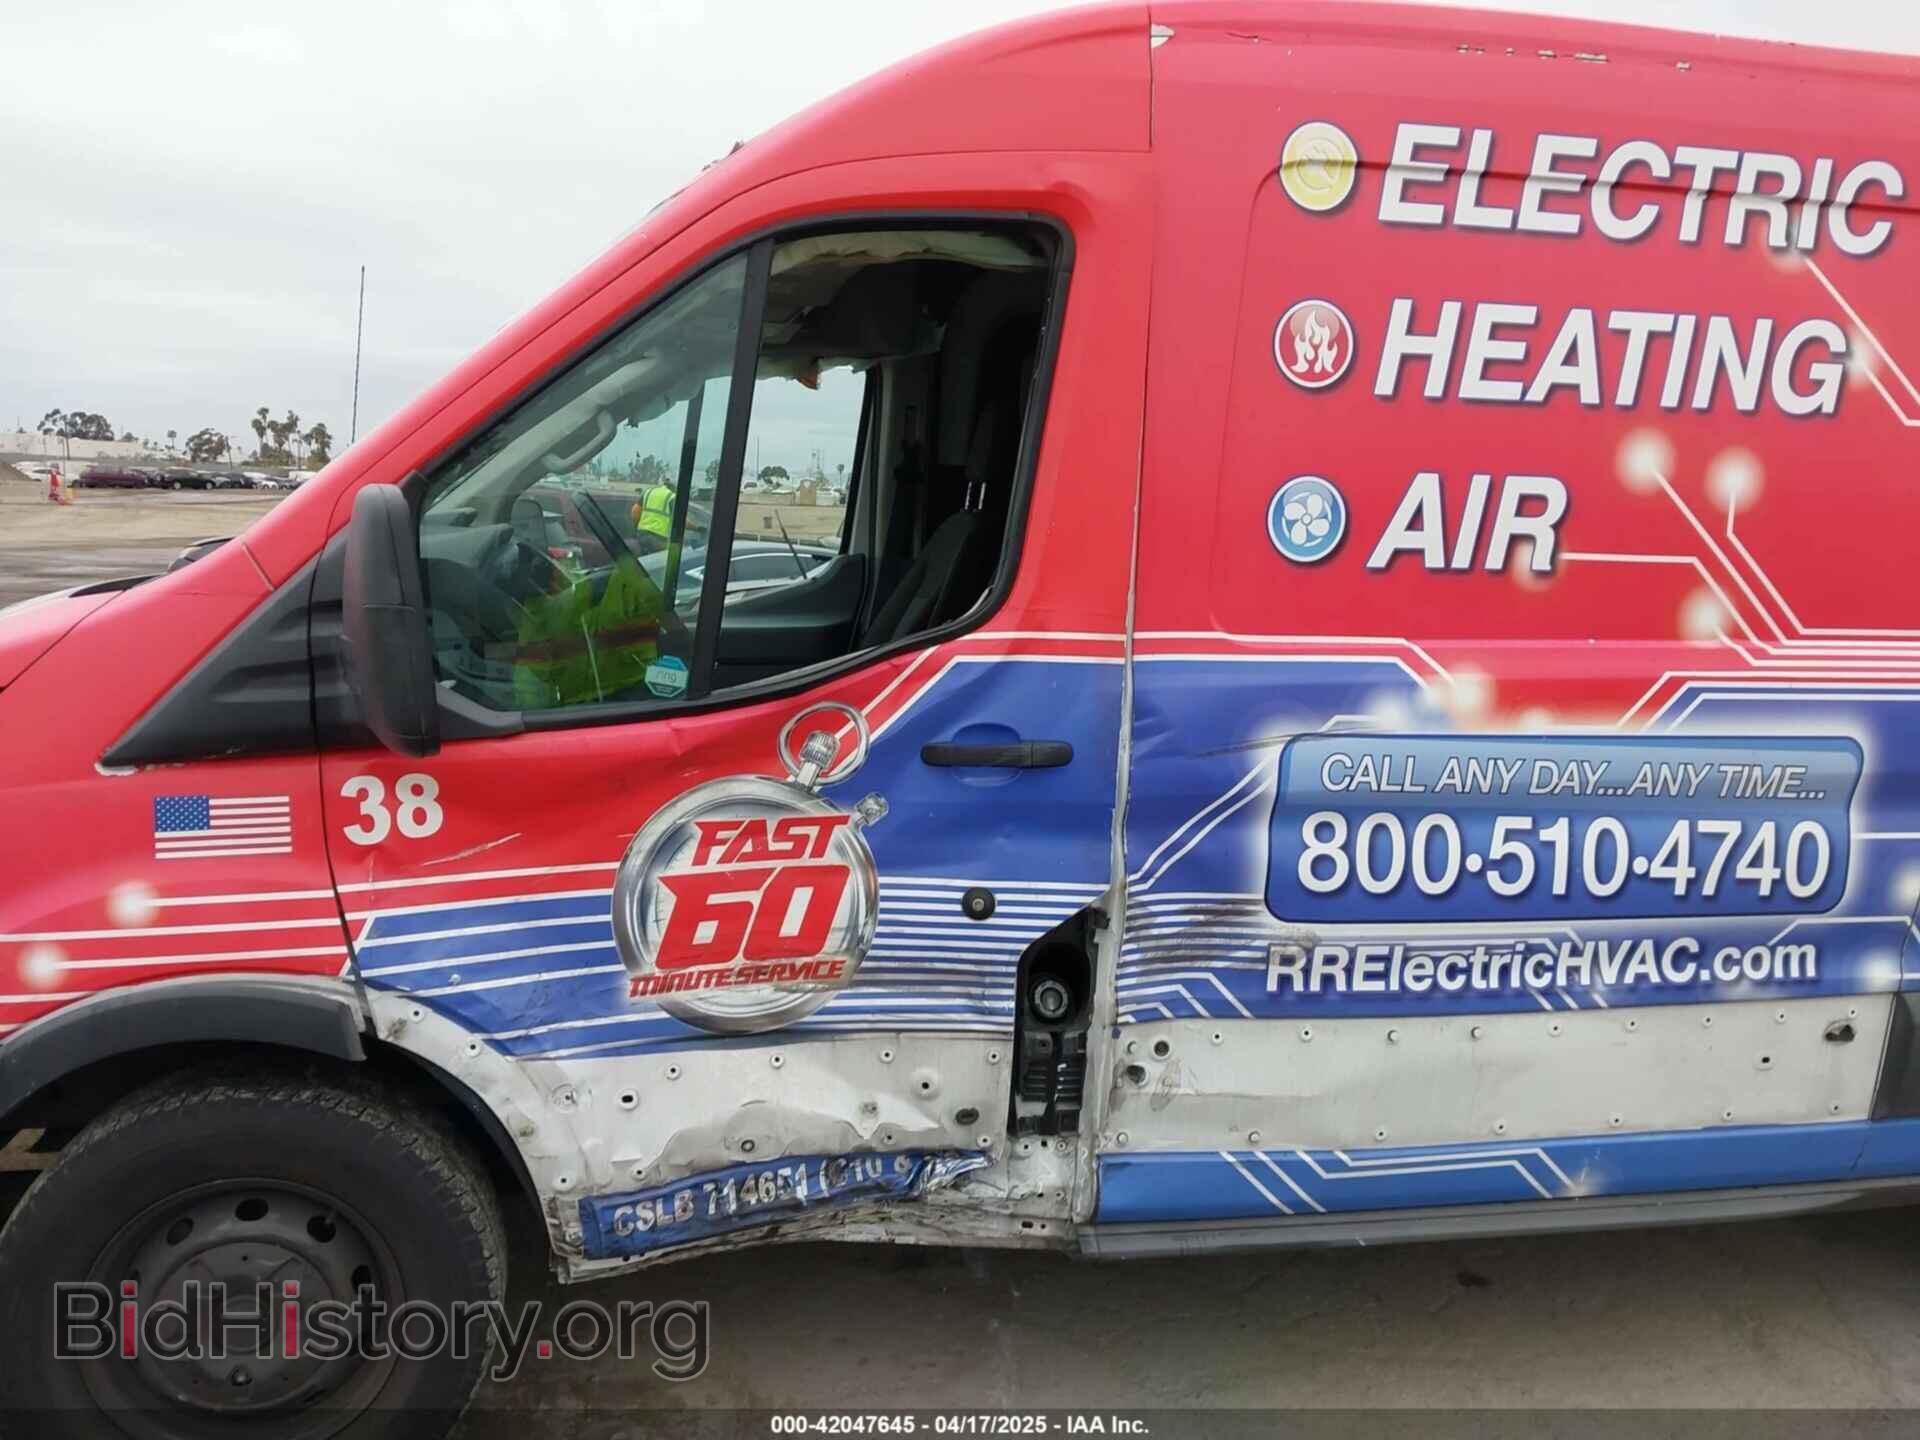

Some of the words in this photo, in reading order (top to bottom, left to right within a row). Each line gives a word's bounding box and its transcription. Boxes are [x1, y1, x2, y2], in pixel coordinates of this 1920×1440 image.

[1378, 122, 1904, 255] ELECTRIC
[1373, 298, 1846, 415] HEATING
[1366, 472, 1568, 571] AIR
[340, 773, 443, 846] 38
[1321, 753, 1425, 793] CALL
[1435, 757, 1527, 795] ANY
[1718, 764, 1826, 800] TIME...
[693, 815, 850, 864] FAST
[655, 866, 850, 969] 60
[1265, 938, 1817, 993] RRElectricHVAC.com
[614, 1189, 694, 1237] CSLB
